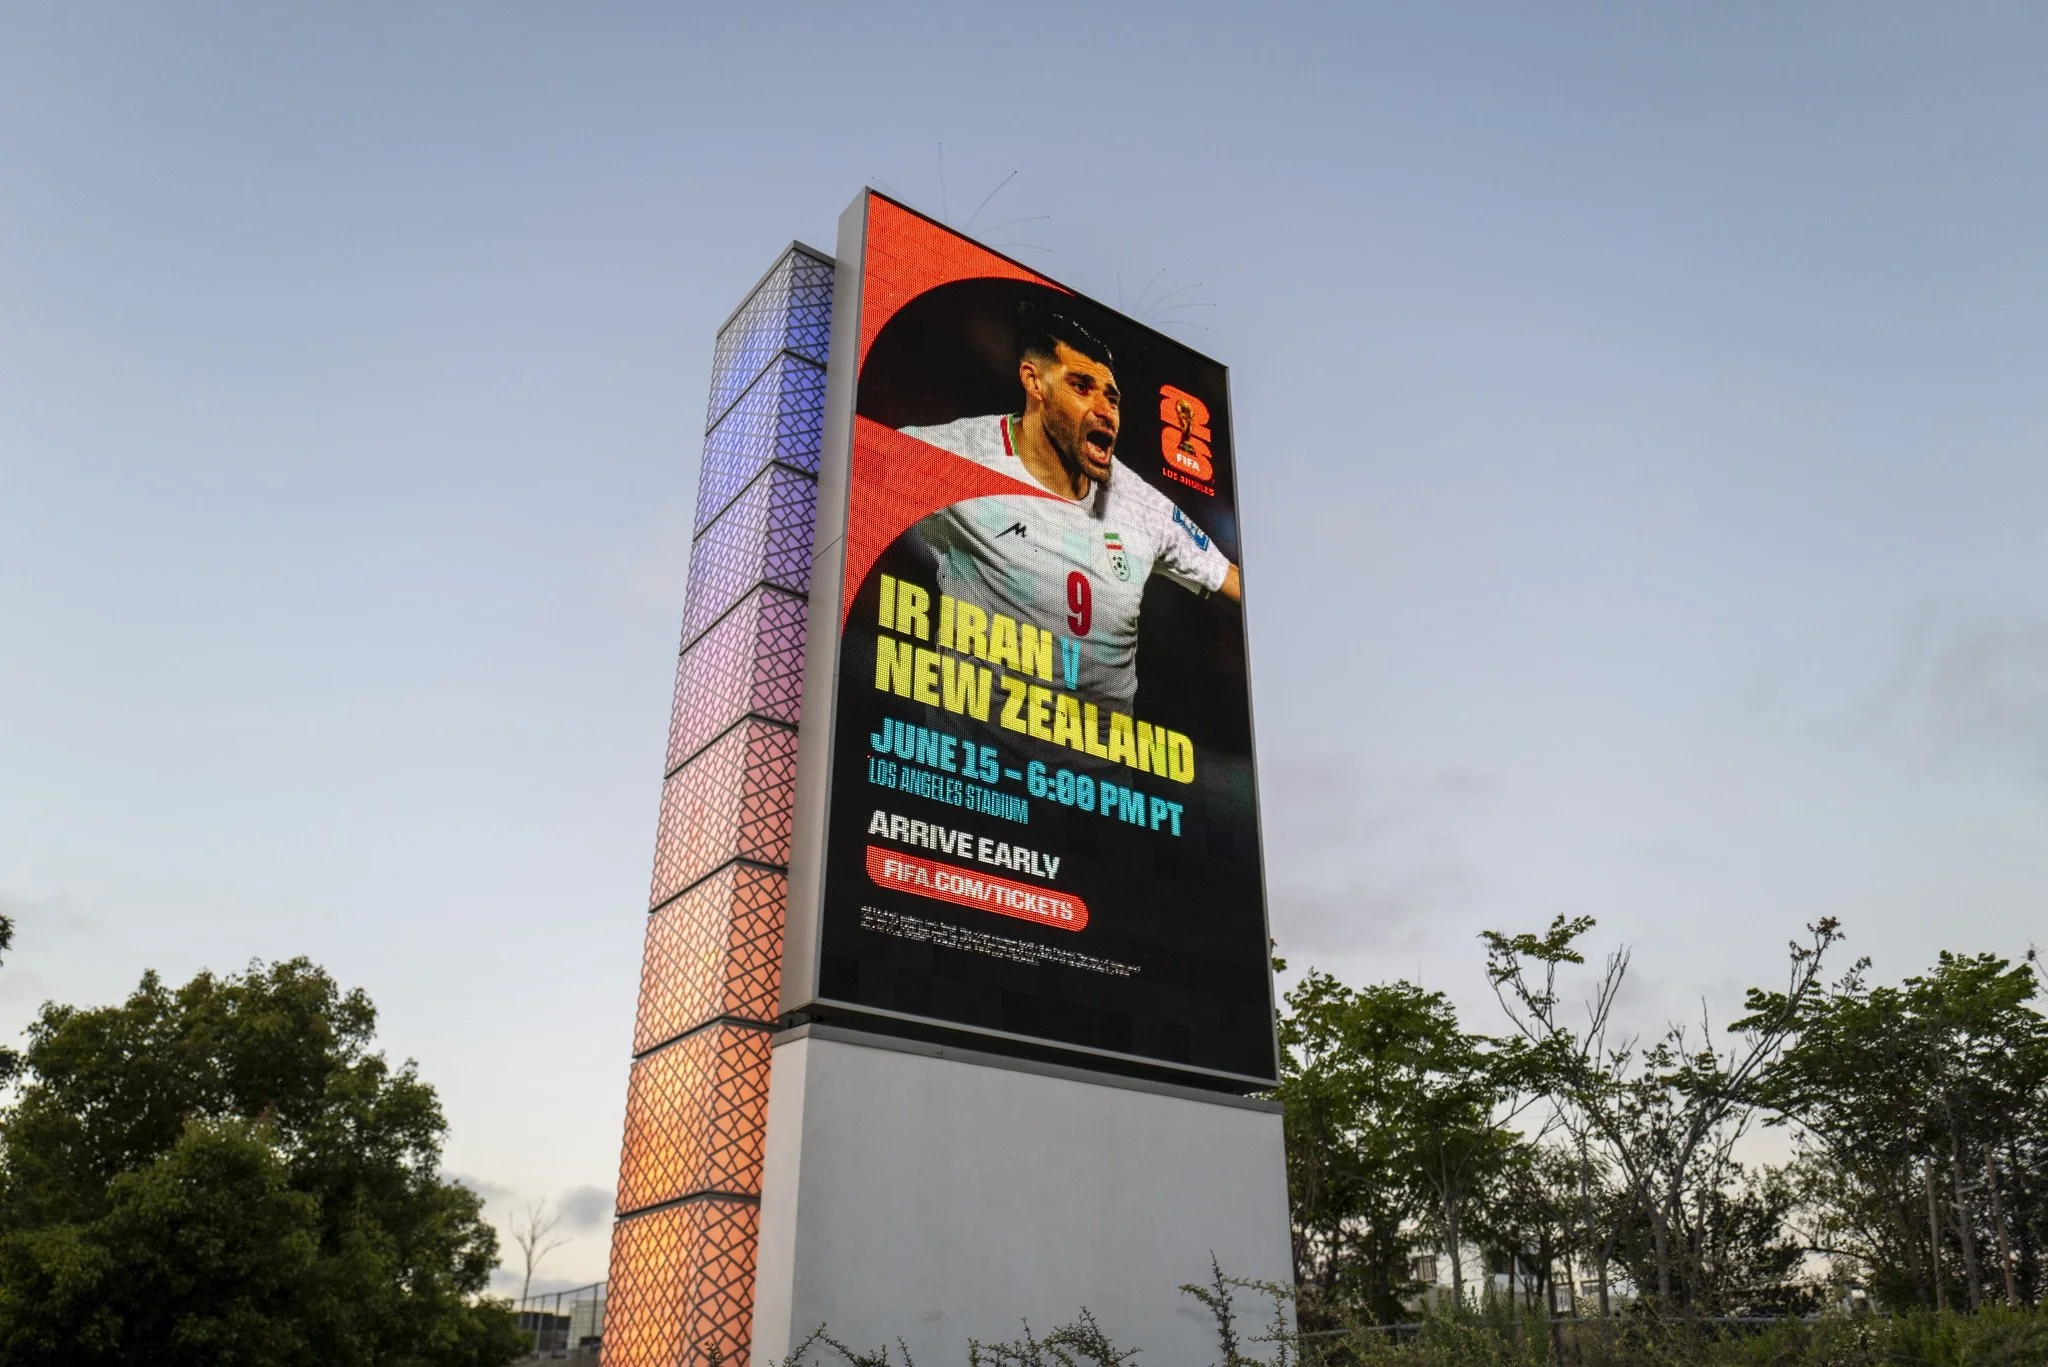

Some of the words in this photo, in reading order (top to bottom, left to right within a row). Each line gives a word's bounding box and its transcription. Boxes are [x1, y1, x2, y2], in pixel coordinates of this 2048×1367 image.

[1162, 467, 1178, 481] LOS
[1176, 453, 1200, 472] FIFA
[878, 573, 930, 641] IR
[938, 595, 1053, 682] IRAN
[1067, 571, 1092, 636] 9
[875, 634, 993, 722] NEW
[1000, 675, 1195, 785] ZEALAND
[868, 757, 896, 789] LOS
[899, 765, 964, 807] ANGELES
[964, 785, 1029, 825] STADIUM
[870, 717, 958, 773] JUNE
[961, 739, 1000, 784] 15
[1026, 760, 1096, 812] 6:00
[1100, 780, 1147, 827] PM
[1149, 796, 1184, 837] PT
[867, 809, 974, 859] ARRIVE
[977, 836, 1061, 880] EARLY
[883, 857, 1074, 921] FIFA.COM/TICKETS
